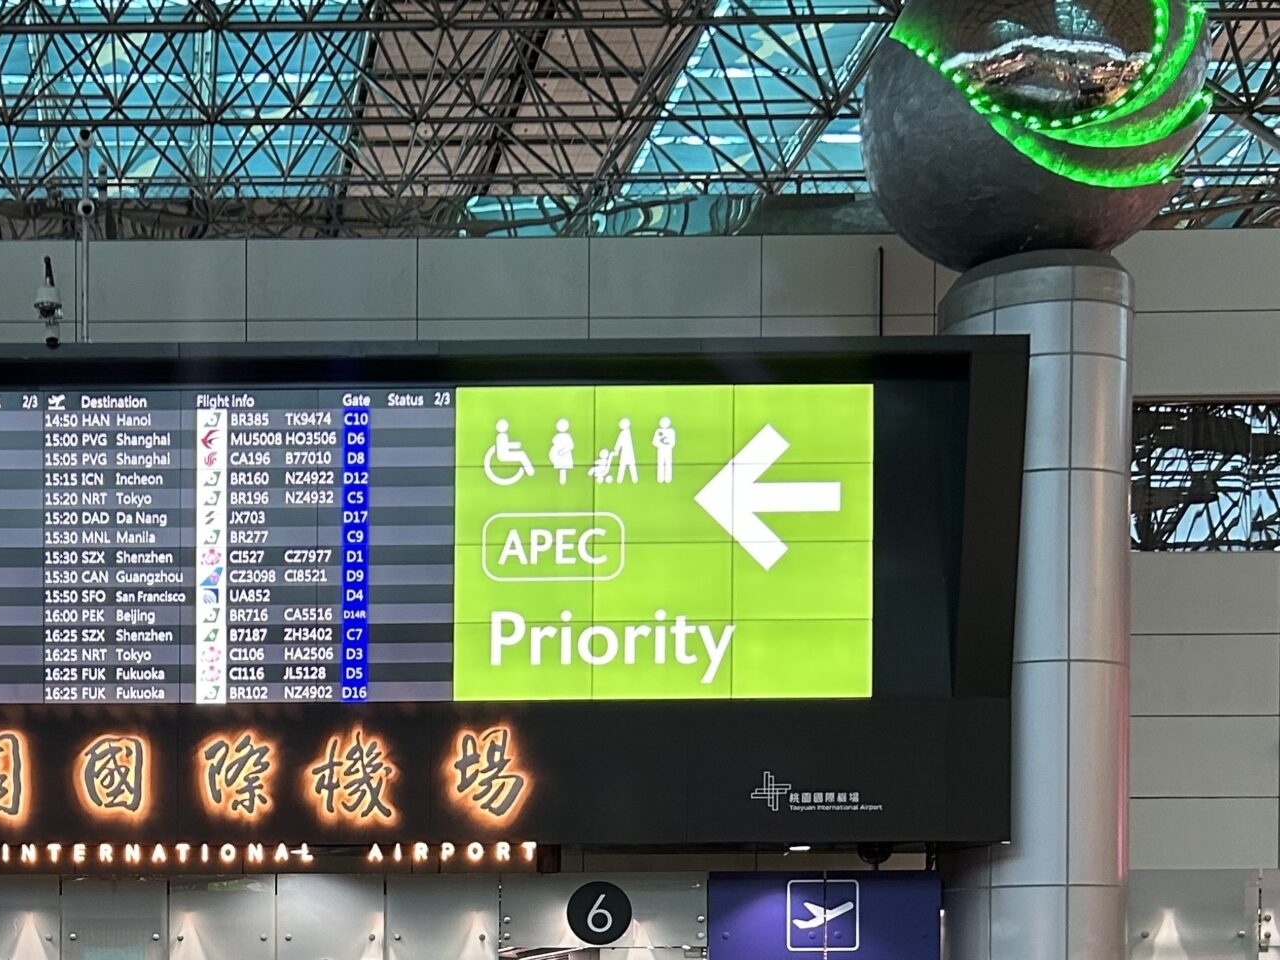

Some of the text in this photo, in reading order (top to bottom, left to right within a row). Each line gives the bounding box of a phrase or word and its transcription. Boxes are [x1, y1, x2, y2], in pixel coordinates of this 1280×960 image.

[23, 396, 37, 408] 2/3
[82, 396, 147, 408] Destination
[197, 394, 254, 409] Flight info
[343, 394, 370, 406] Gate
[388, 394, 423, 406] Status
[435, 392, 450, 405] 2/3
[46, 433, 170, 448] 15:00 PVG Shanghai
[231, 432, 336, 445] MU5008 HO3506
[348, 434, 365, 444] D6
[46, 473, 163, 486] 15:15 ICN Incheon
[231, 472, 333, 485] BR160 NZ4922
[344, 472, 368, 484] D12
[46, 512, 167, 526] 15:20 DAD Da Nang
[230, 511, 265, 524] JX703
[344, 512, 367, 523] D17
[498, 527, 608, 566] APEC
[46, 551, 172, 564] 15:30 SZX Shenzhen
[230, 550, 331, 563] CI527 CZ7977
[347, 551, 362, 562] D1
[46, 590, 185, 602] 15:50 SFO San Francisco
[230, 590, 270, 602] UA852
[347, 590, 363, 601] D4
[46, 629, 172, 642] 16:25 SZX Shenzhen
[230, 628, 332, 641] B7187 ZH3402
[347, 629, 362, 640] C7
[489, 608, 736, 684] Priority
[46, 667, 164, 680] 16:25 FUK Fukuoka
[229, 667, 326, 680] CI116 JL5128
[346, 668, 362, 679] D5
[0, 842, 315, 862] INTERNATIONAL
[366, 841, 537, 862] AIRPORT
[587, 893, 612, 933] 6
